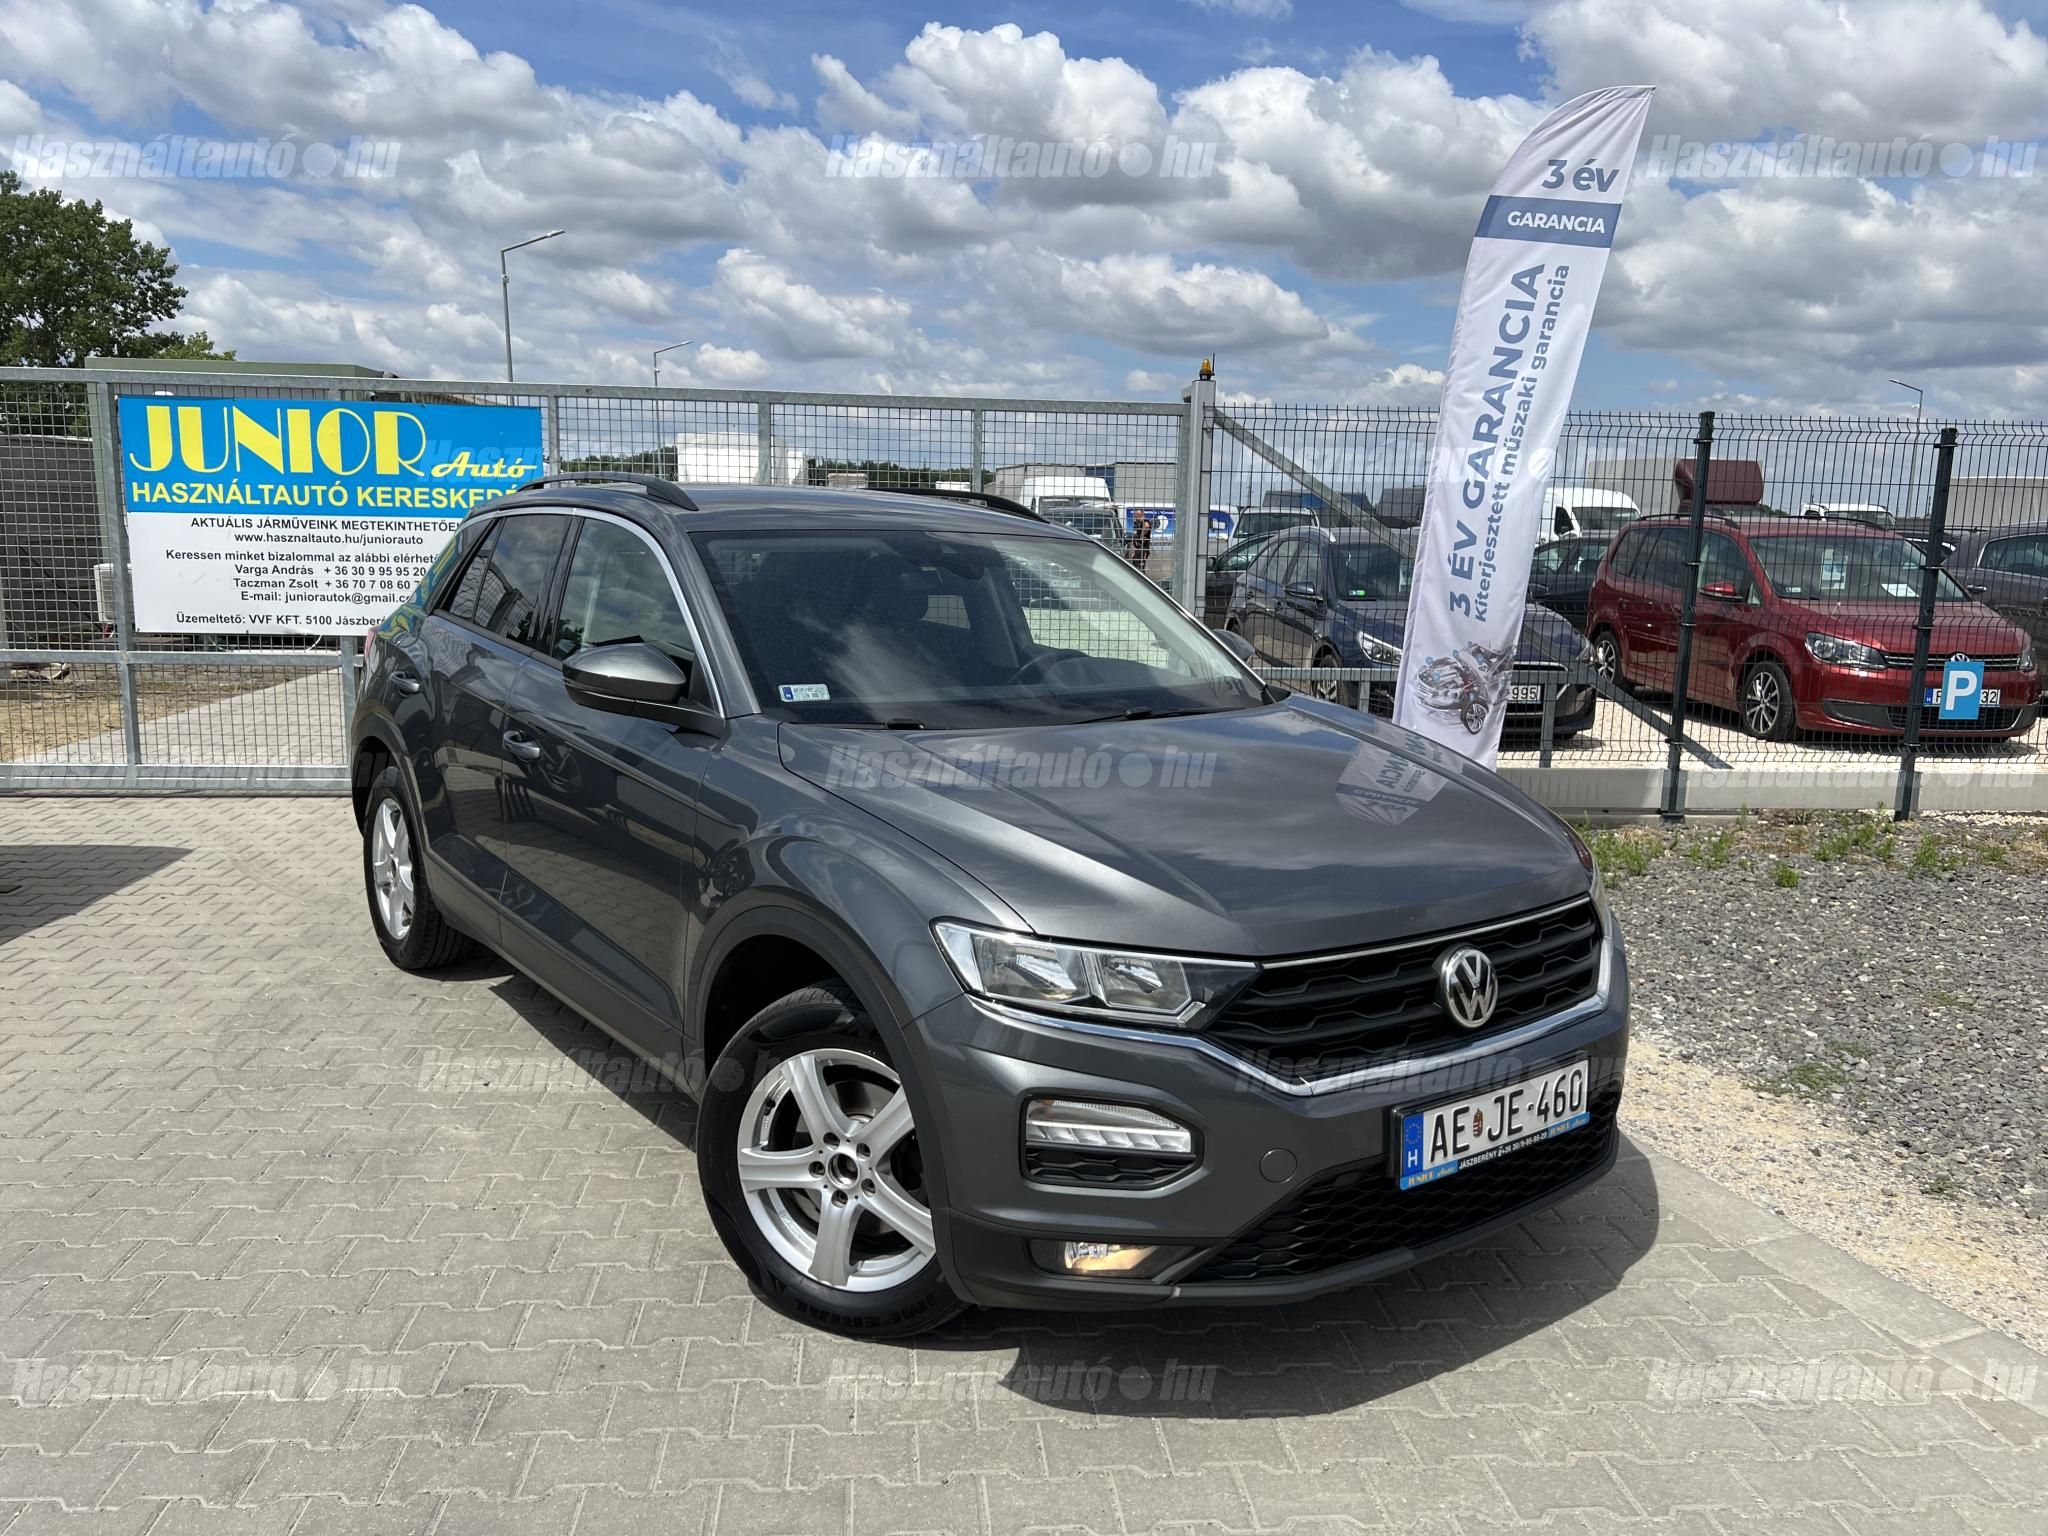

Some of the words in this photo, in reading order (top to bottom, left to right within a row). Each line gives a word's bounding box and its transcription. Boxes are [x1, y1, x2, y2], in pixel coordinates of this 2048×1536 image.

[1542, 159, 1568, 190] 3
[1572, 158, 1619, 192] év
[1507, 210, 1605, 234] GARANCIA
[1462, 263, 1545, 509] GARANCIA
[129, 405, 426, 477] JUNIOR
[1475, 482, 1510, 622] Kiterjesztett
[1500, 376, 1537, 475] műszaki
[1531, 265, 1569, 370] garancia
[431, 451, 537, 478] Autó
[132, 479, 348, 507] HASZNÁLTAUTÓ
[191, 516, 253, 529] AKTUÁLIS
[234, 532, 424, 546] www.hasznaltauto.hu/juniorauto
[1447, 519, 1477, 580] ÉV
[166, 549, 221, 561] Keressen
[225, 550, 264, 561] minket
[268, 552, 334, 562] bizalommal
[338, 554, 351, 563] az
[355, 552, 389, 563] alábbi
[234, 564, 268, 577] Varga
[272, 565, 314, 576] András
[335, 566, 348, 576] 36
[352, 566, 365, 576] 30
[368, 566, 375, 576] 9
[378, 566, 392, 576] 95
[395, 566, 409, 576] 95
[413, 567, 426, 577] 20
[233, 577, 285, 589] Taczman
[289, 578, 318, 589] Zsolt
[335, 579, 349, 589] 36
[353, 580, 366, 589] 70
[369, 580, 376, 589] 7
[380, 580, 394, 590] 08
[397, 580, 411, 590] 60
[241, 591, 281, 602] E-mail:
[1449, 590, 1471, 618] 3
[248, 614, 272, 624] VVF
[276, 615, 302, 625] KFT.
[305, 615, 332, 626] 5100
[1945, 670, 1977, 711] P
[1408, 1149, 1418, 1168] H
[1459, 1149, 1498, 1170] JÁSZBERÉNY
